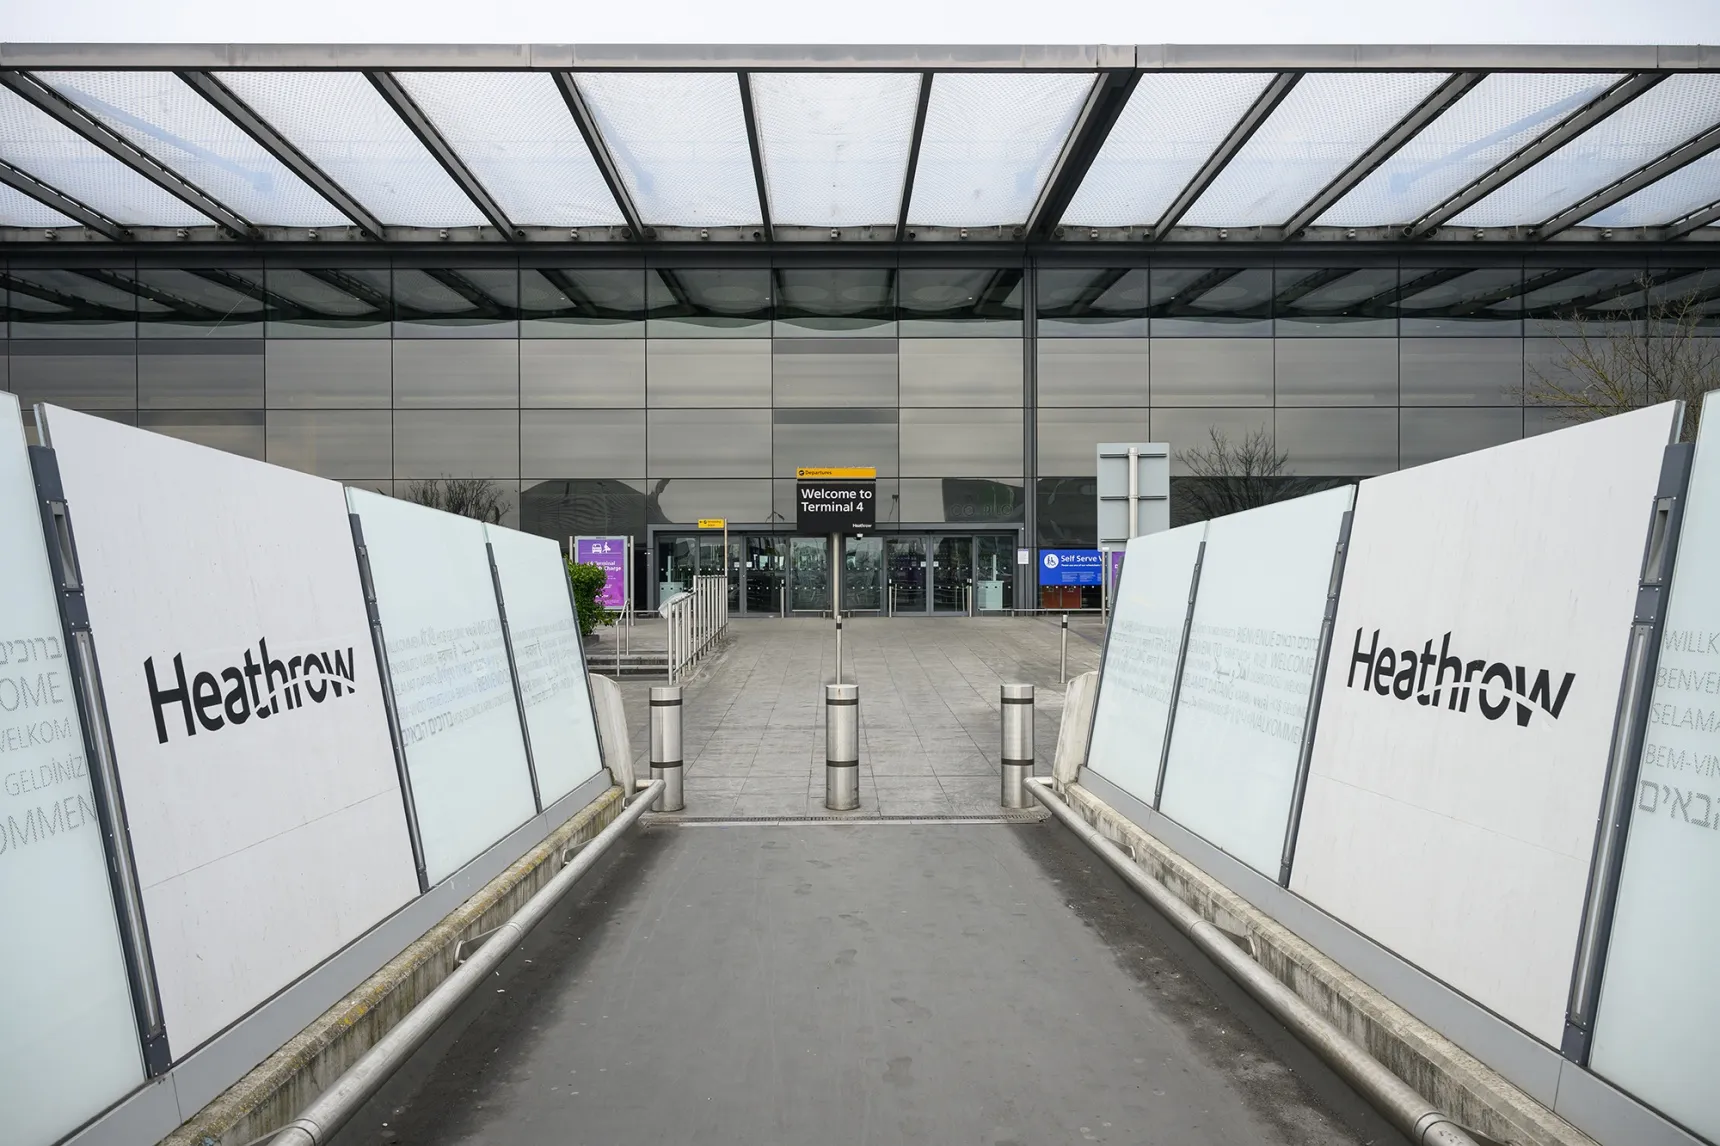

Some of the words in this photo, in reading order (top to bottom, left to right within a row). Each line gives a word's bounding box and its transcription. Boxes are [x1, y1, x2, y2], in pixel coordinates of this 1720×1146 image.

[801, 488, 857, 499] Welcome
[859, 489, 873, 499] to
[801, 501, 854, 512] Terminal
[856, 502, 864, 512] 4
[143, 636, 356, 744] Heathrow
[1347, 626, 1577, 727] Heathrow
